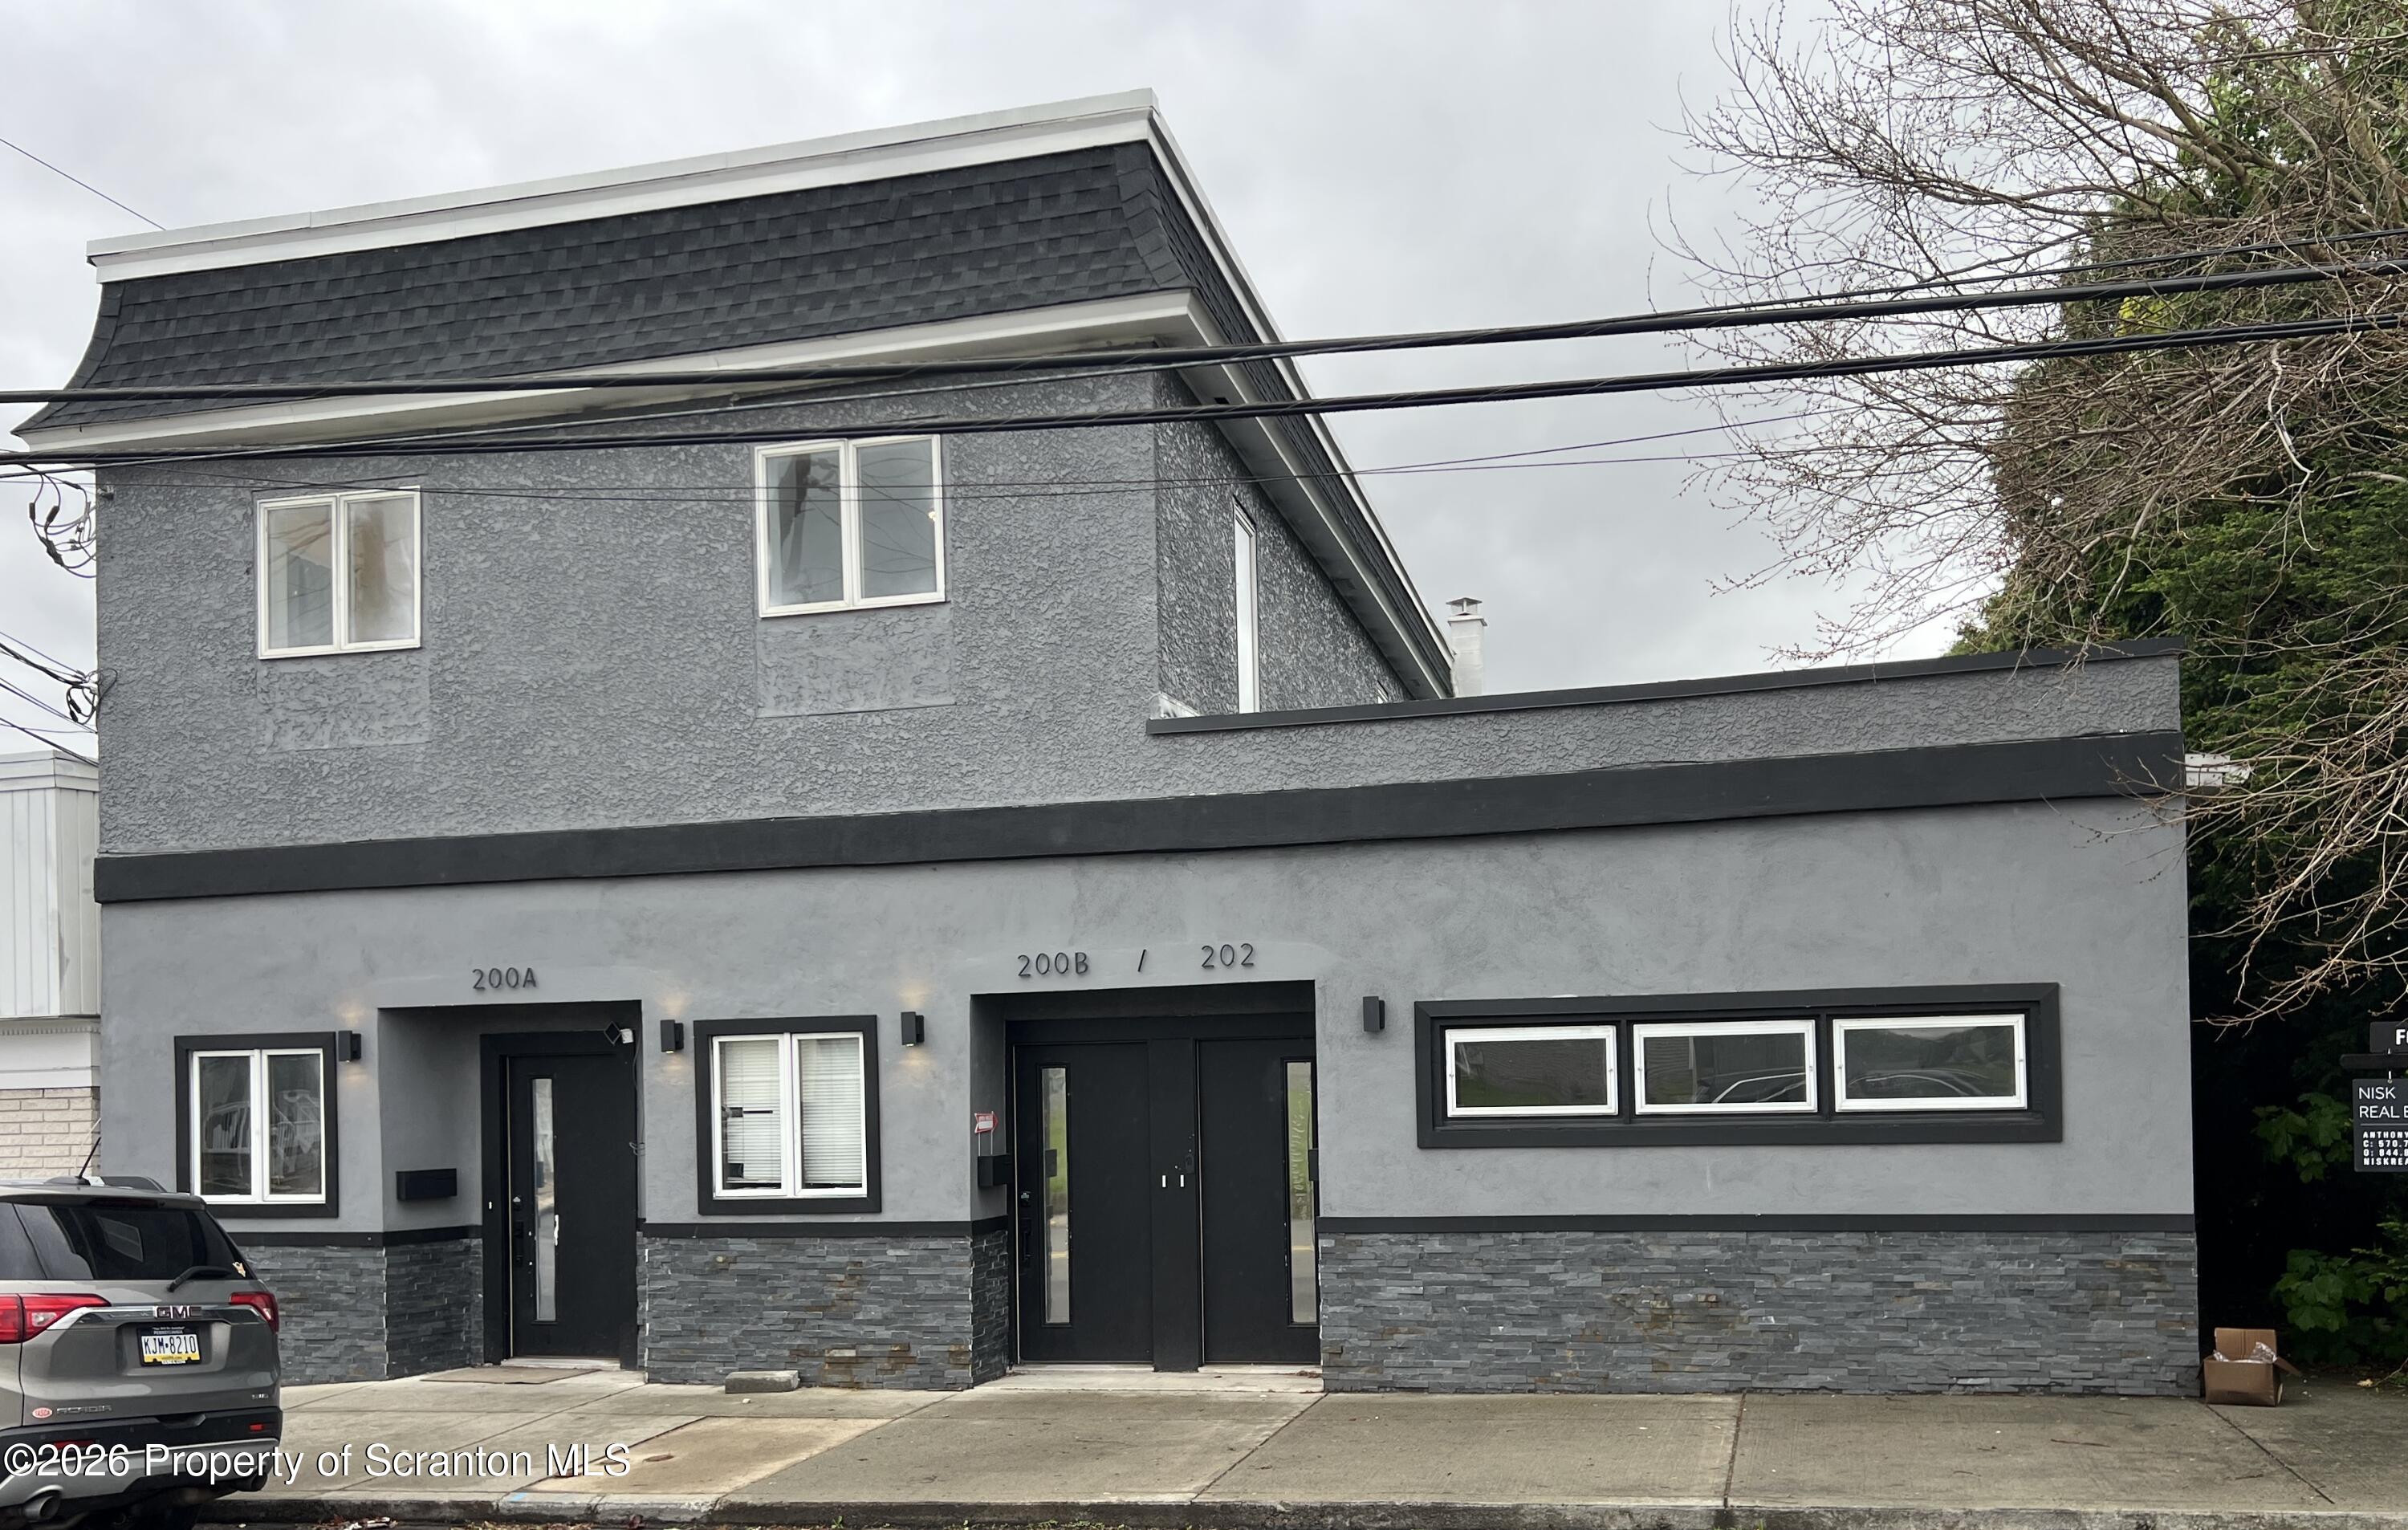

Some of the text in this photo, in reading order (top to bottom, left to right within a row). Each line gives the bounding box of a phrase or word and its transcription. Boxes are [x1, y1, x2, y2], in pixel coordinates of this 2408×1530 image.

[1018, 952, 1088, 978] 200B
[1202, 942, 1255, 969] 202
[472, 967, 537, 990] 200A
[2396, 1029, 2408, 1045] F
[2359, 1086, 2396, 1100] NISK
[2359, 1105, 2400, 1118] REAL
[153, 1305, 201, 1319] GMC
